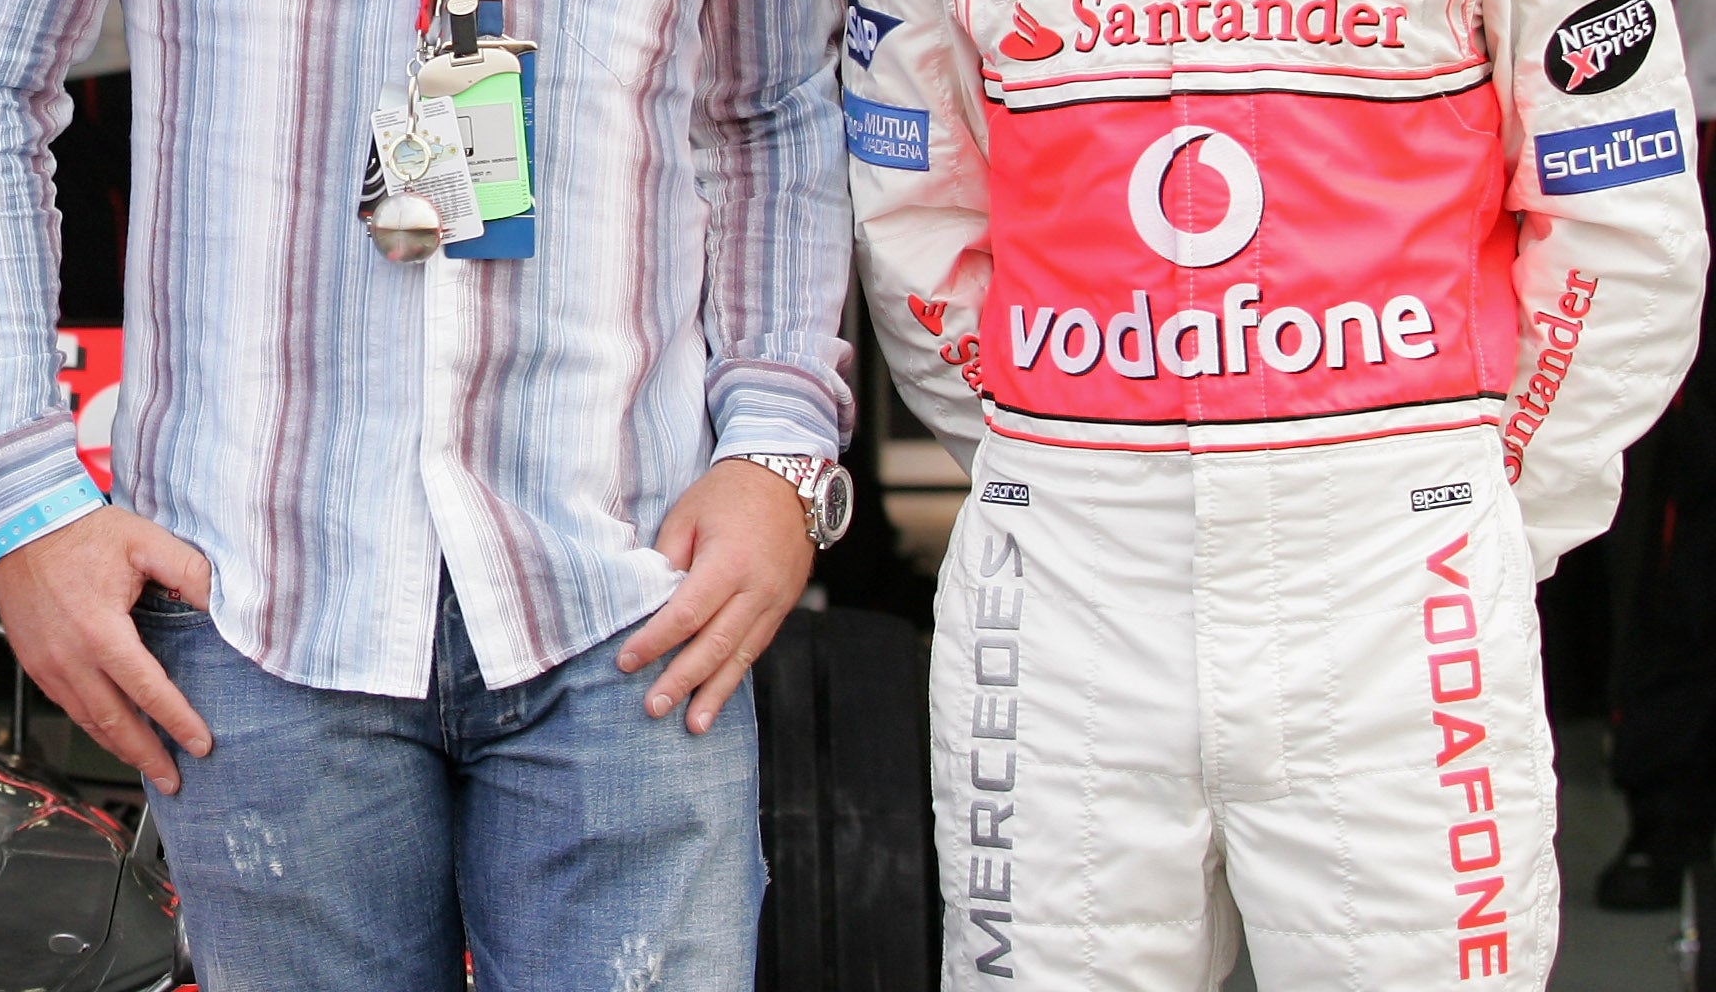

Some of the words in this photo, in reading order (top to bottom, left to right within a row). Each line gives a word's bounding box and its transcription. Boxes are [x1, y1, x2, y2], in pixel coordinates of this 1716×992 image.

[864, 113, 922, 143] MUTUA
[1010, 283, 1438, 380] vodafone
[982, 483, 1028, 502] sparco
[1411, 483, 1472, 510] sparco
[969, 531, 1024, 979] MERCEDES
[1424, 532, 1509, 982] VODAFONE
